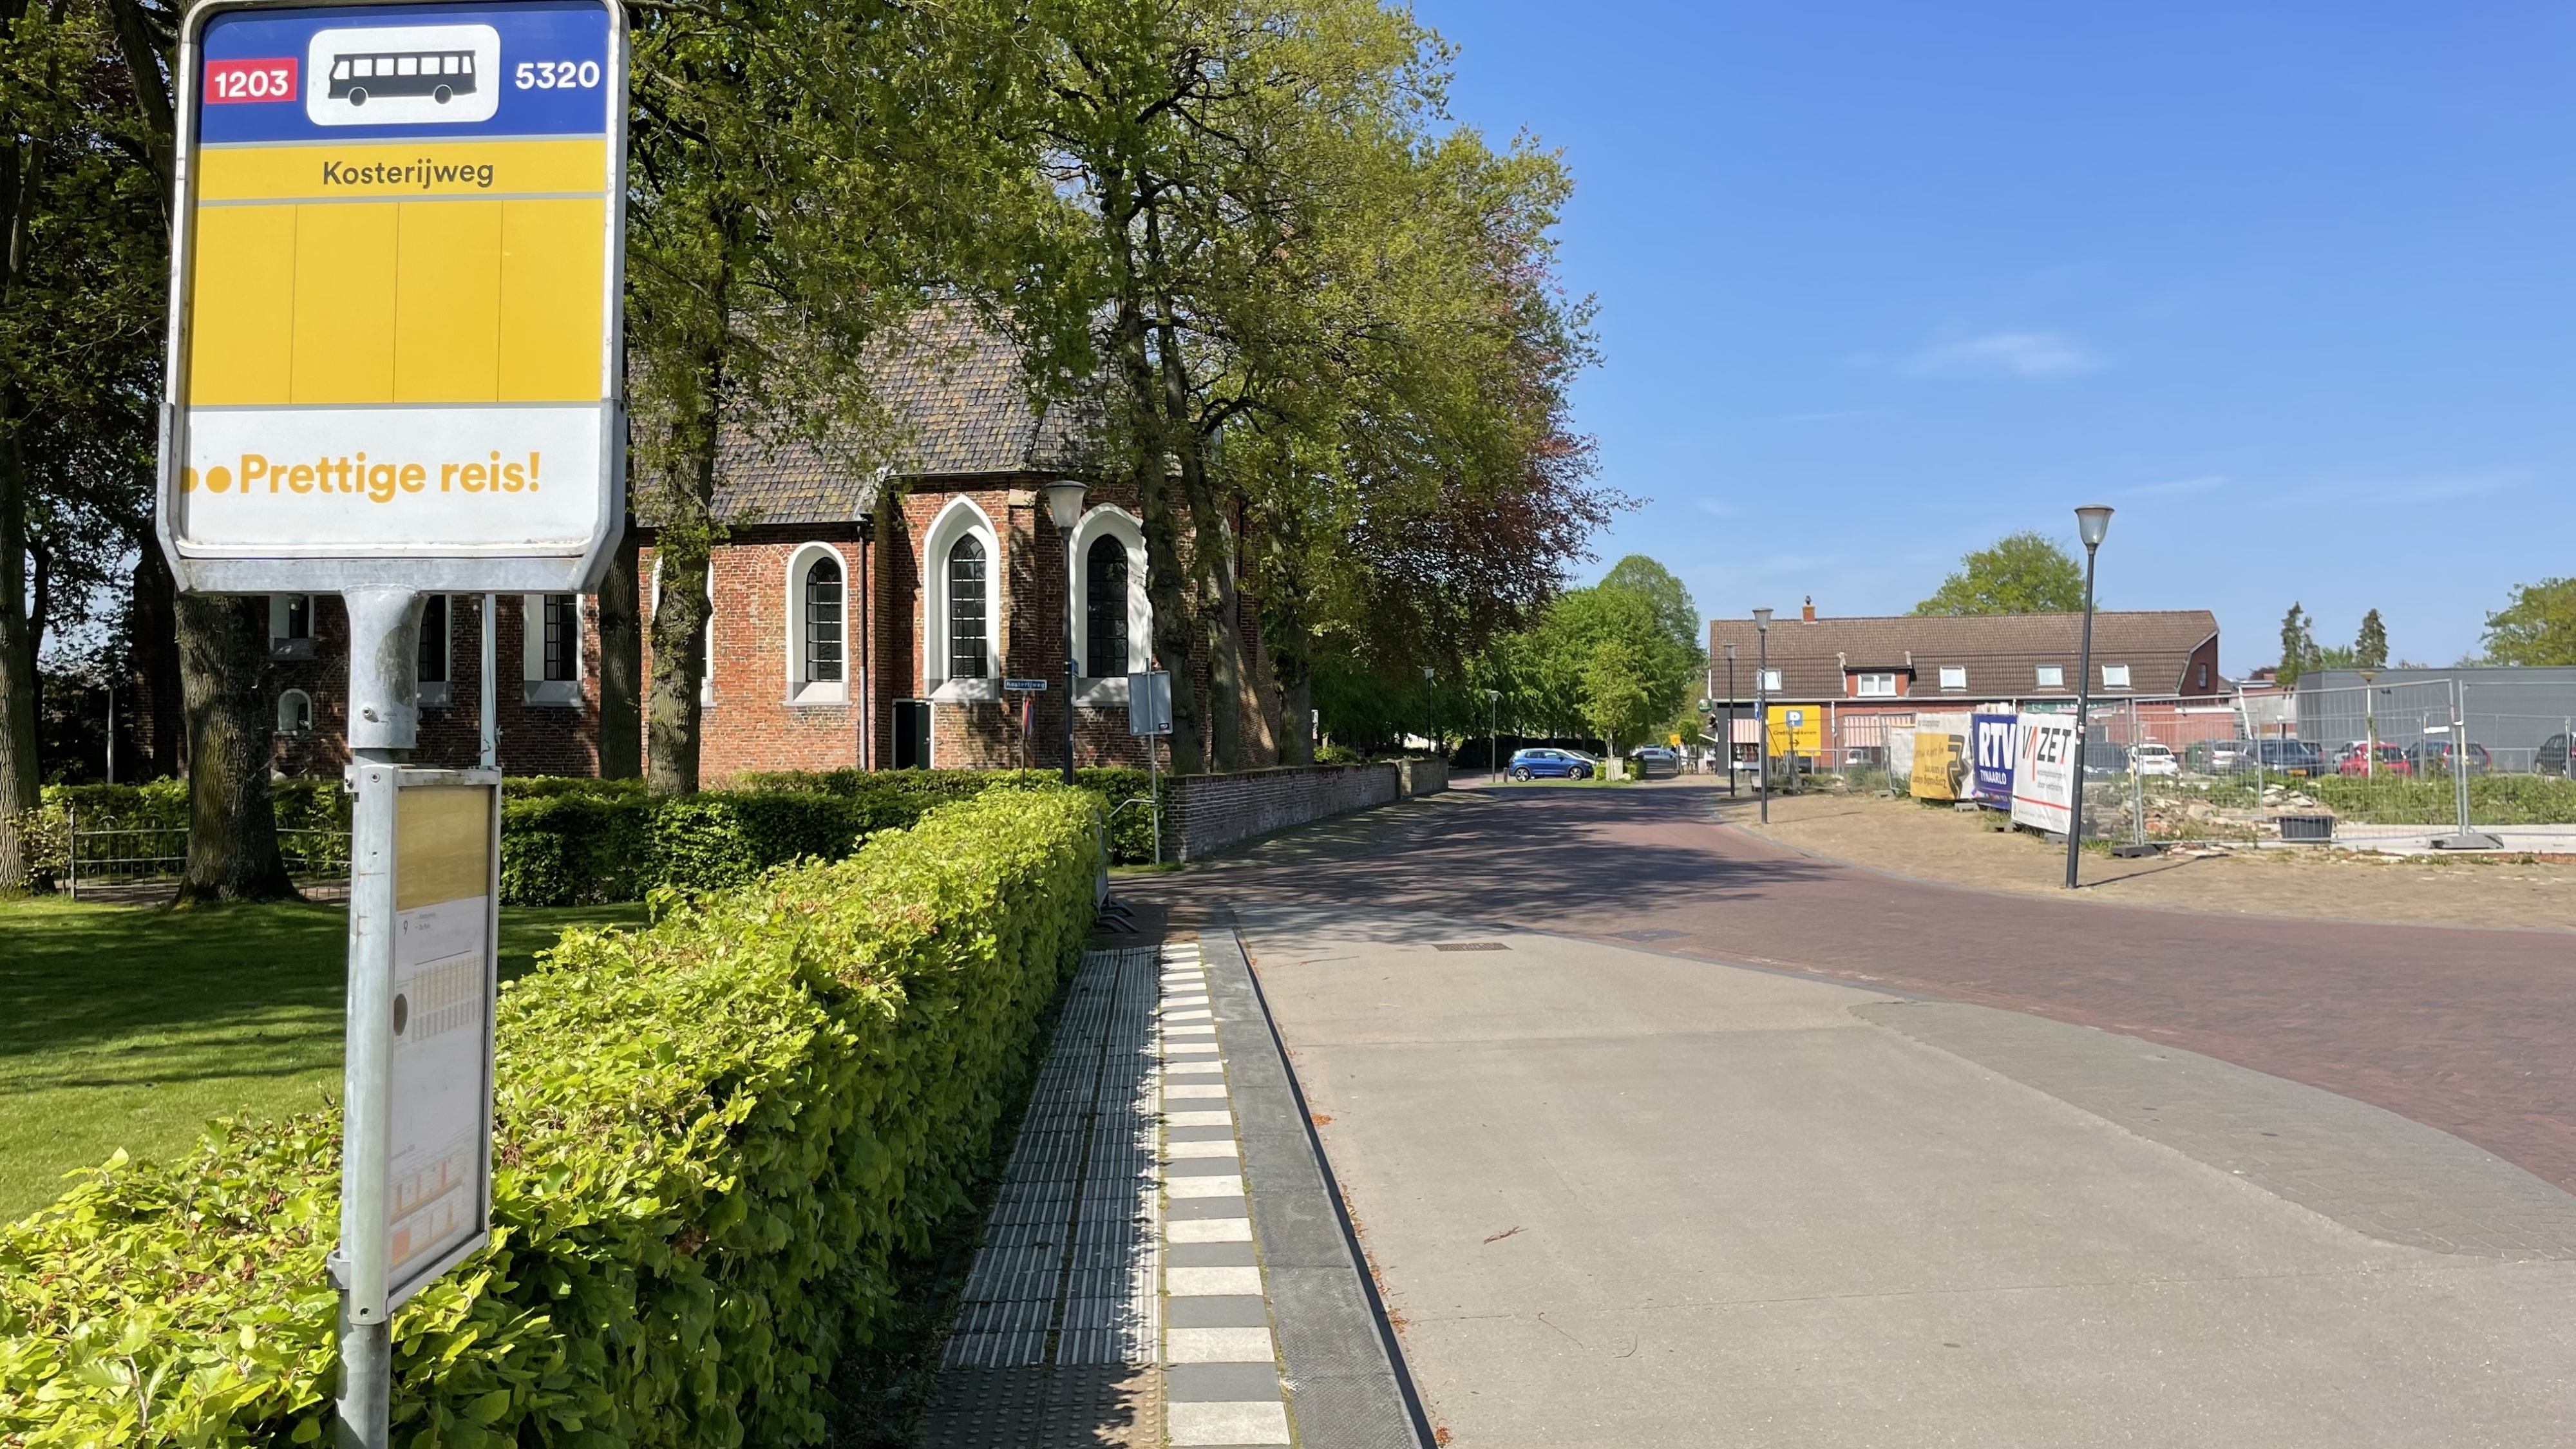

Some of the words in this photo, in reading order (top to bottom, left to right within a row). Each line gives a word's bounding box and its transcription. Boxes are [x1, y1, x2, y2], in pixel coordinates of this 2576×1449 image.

[214, 70, 289, 99] 1203
[515, 61, 600, 90] 5320
[323, 158, 495, 189] Kosterijweg
[241, 451, 426, 503] Prettige
[440, 450, 540, 493] reis!
[1979, 722, 2016, 770] RTV
[1980, 770, 2007, 785] TYNAARLO
[404, 920, 408, 935] 9
